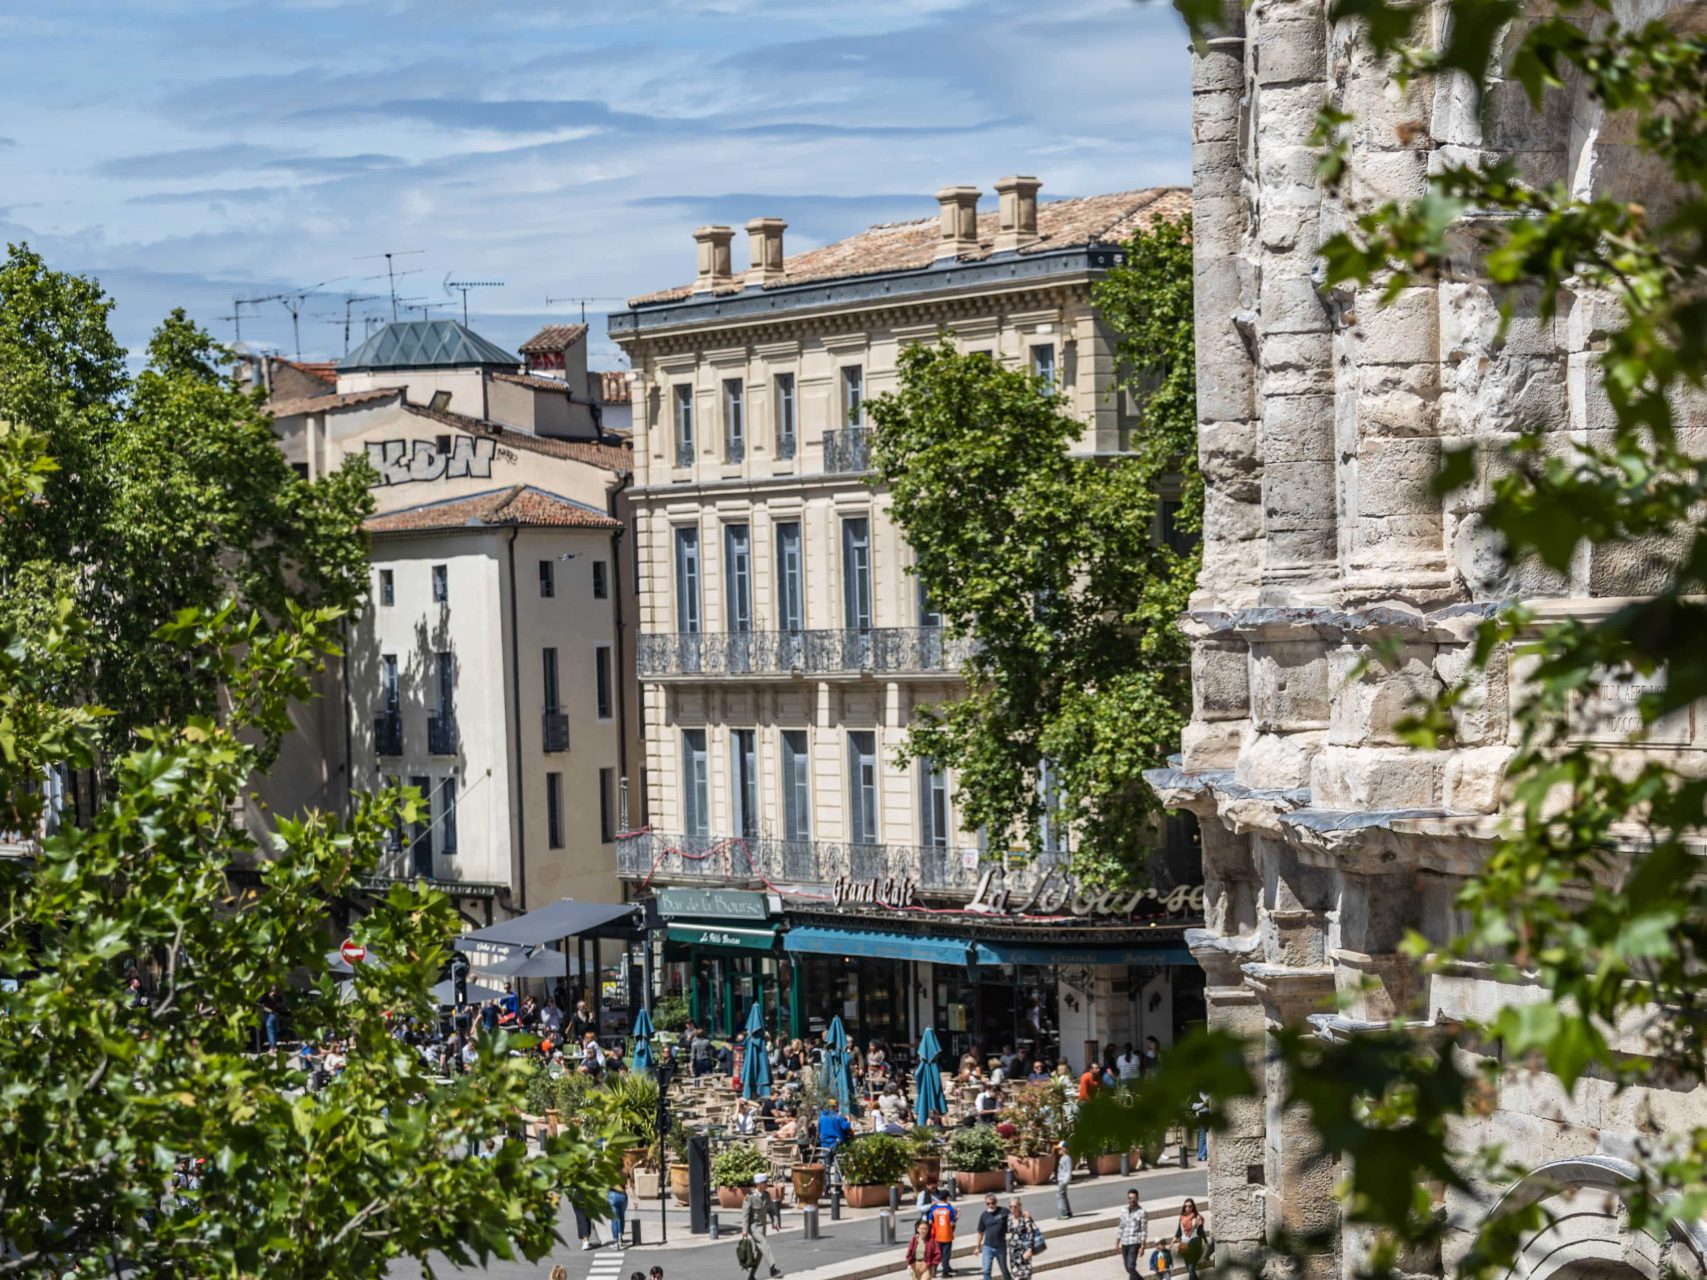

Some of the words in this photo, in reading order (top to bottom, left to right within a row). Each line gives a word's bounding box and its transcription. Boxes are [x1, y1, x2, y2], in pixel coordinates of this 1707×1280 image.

[661, 893, 683, 911] Bar
[686, 896, 700, 911] de
[702, 897, 713, 912] la
[714, 895, 762, 914] Bourse
[832, 876, 878, 907] Grand
[881, 877, 916, 907] Café
[965, 868, 1011, 914] La
[1008, 952, 1027, 963] La
